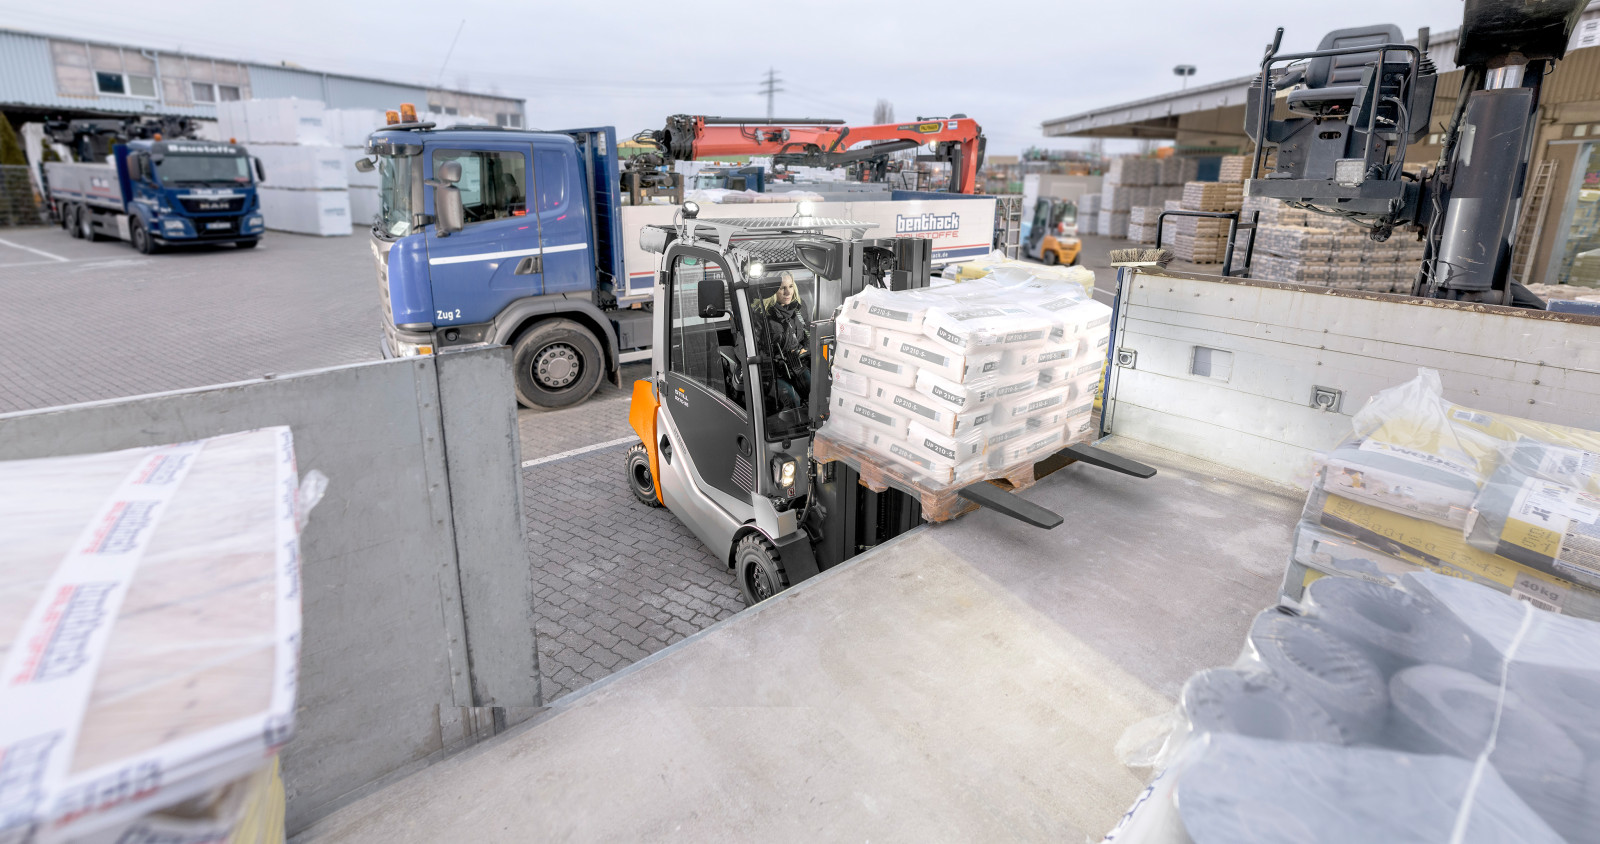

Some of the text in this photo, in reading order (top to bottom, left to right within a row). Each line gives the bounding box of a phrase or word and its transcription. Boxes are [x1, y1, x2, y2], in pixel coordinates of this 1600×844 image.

[896, 212, 960, 233] benthack
[436, 308, 462, 321] Zug 2
[946, 334, 959, 343] 210
[909, 347, 920, 355] 210
[674, 388, 689, 401] STILL
[934, 387, 943, 395] UP
[943, 392, 956, 402] 210
[902, 400, 912, 409] 210
[926, 440, 934, 448] UP
[934, 445, 946, 455] 210
